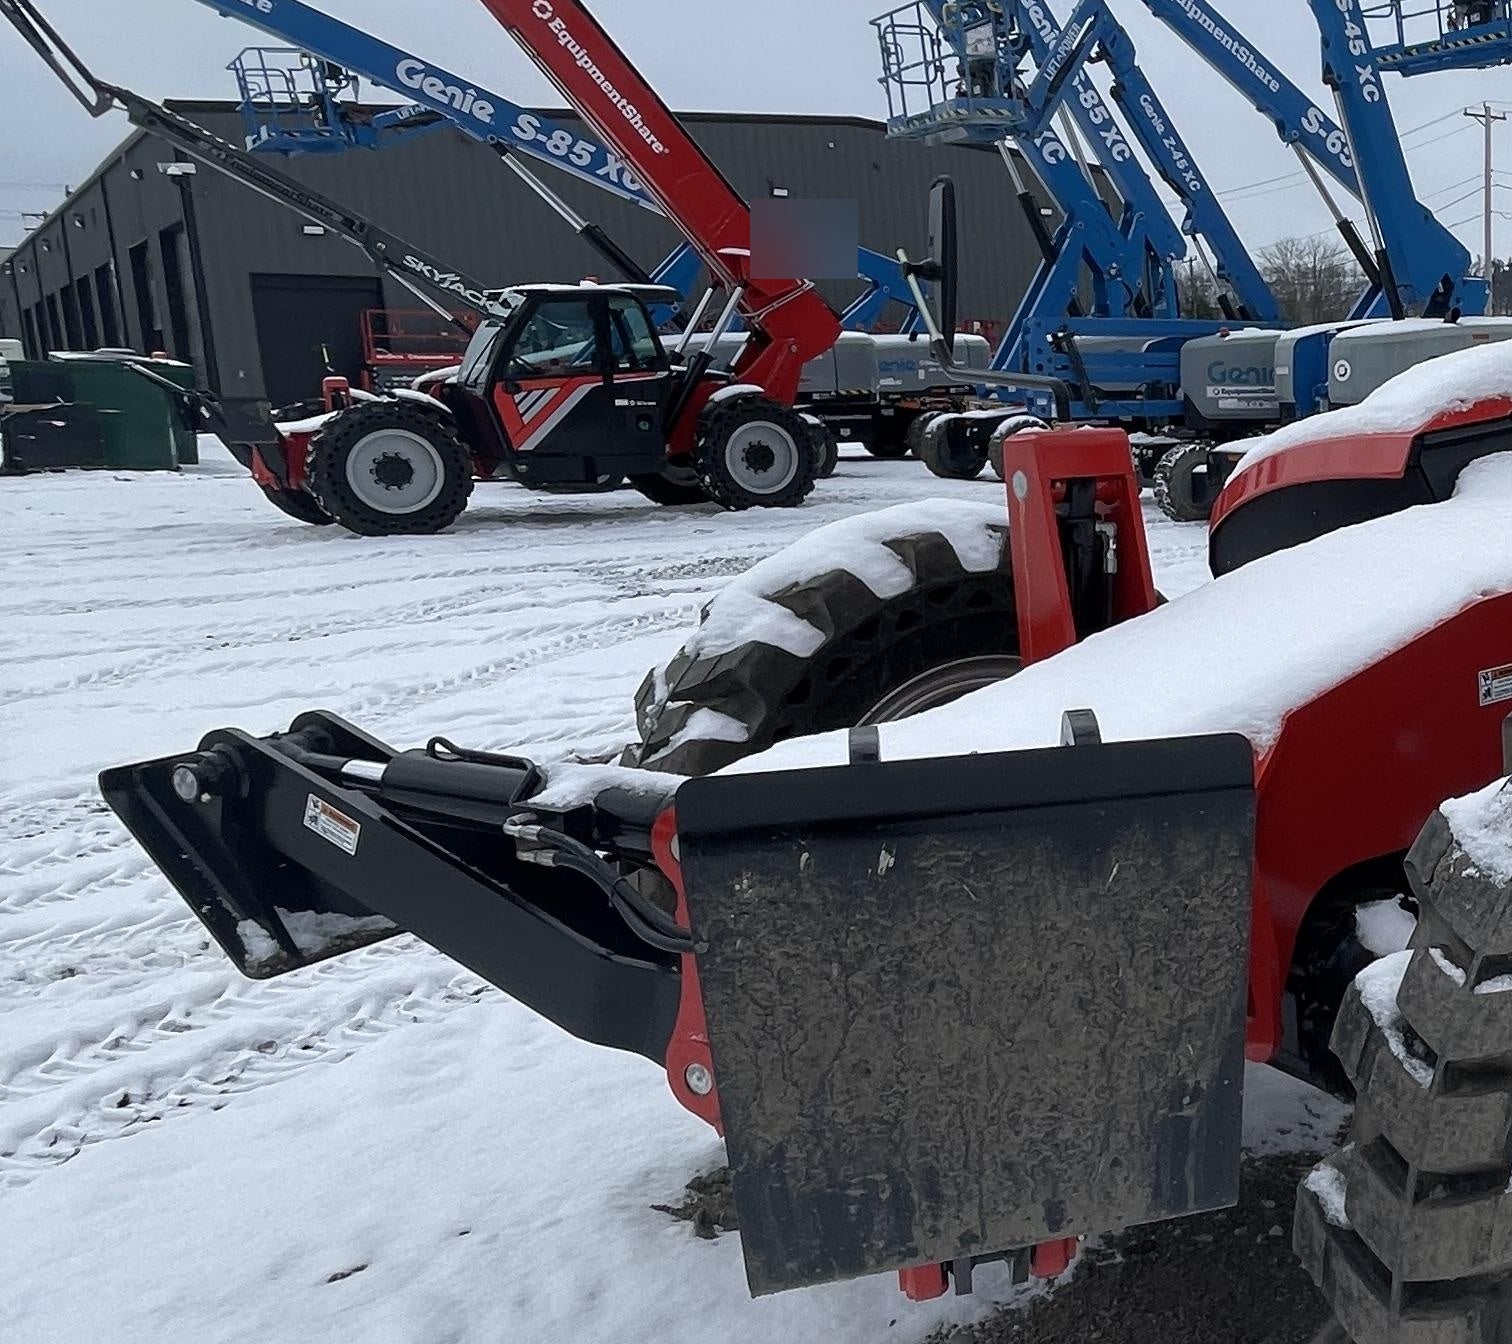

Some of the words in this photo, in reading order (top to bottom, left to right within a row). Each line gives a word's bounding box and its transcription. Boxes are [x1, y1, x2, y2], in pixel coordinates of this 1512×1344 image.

[1043, 58, 1061, 81] LIFT
[1058, 22, 1081, 58] POWER
[396, 58, 496, 124] Genie
[511, 114, 597, 167] S-85
[548, 16, 664, 154] EquipmentShare
[1354, 64, 1380, 103] XC
[1101, 125, 1131, 162] XC
[1139, 94, 1165, 136] Genie
[1163, 136, 1189, 170] Z-45
[1182, 167, 1201, 192] XC
[1207, 360, 1275, 385] Geni
